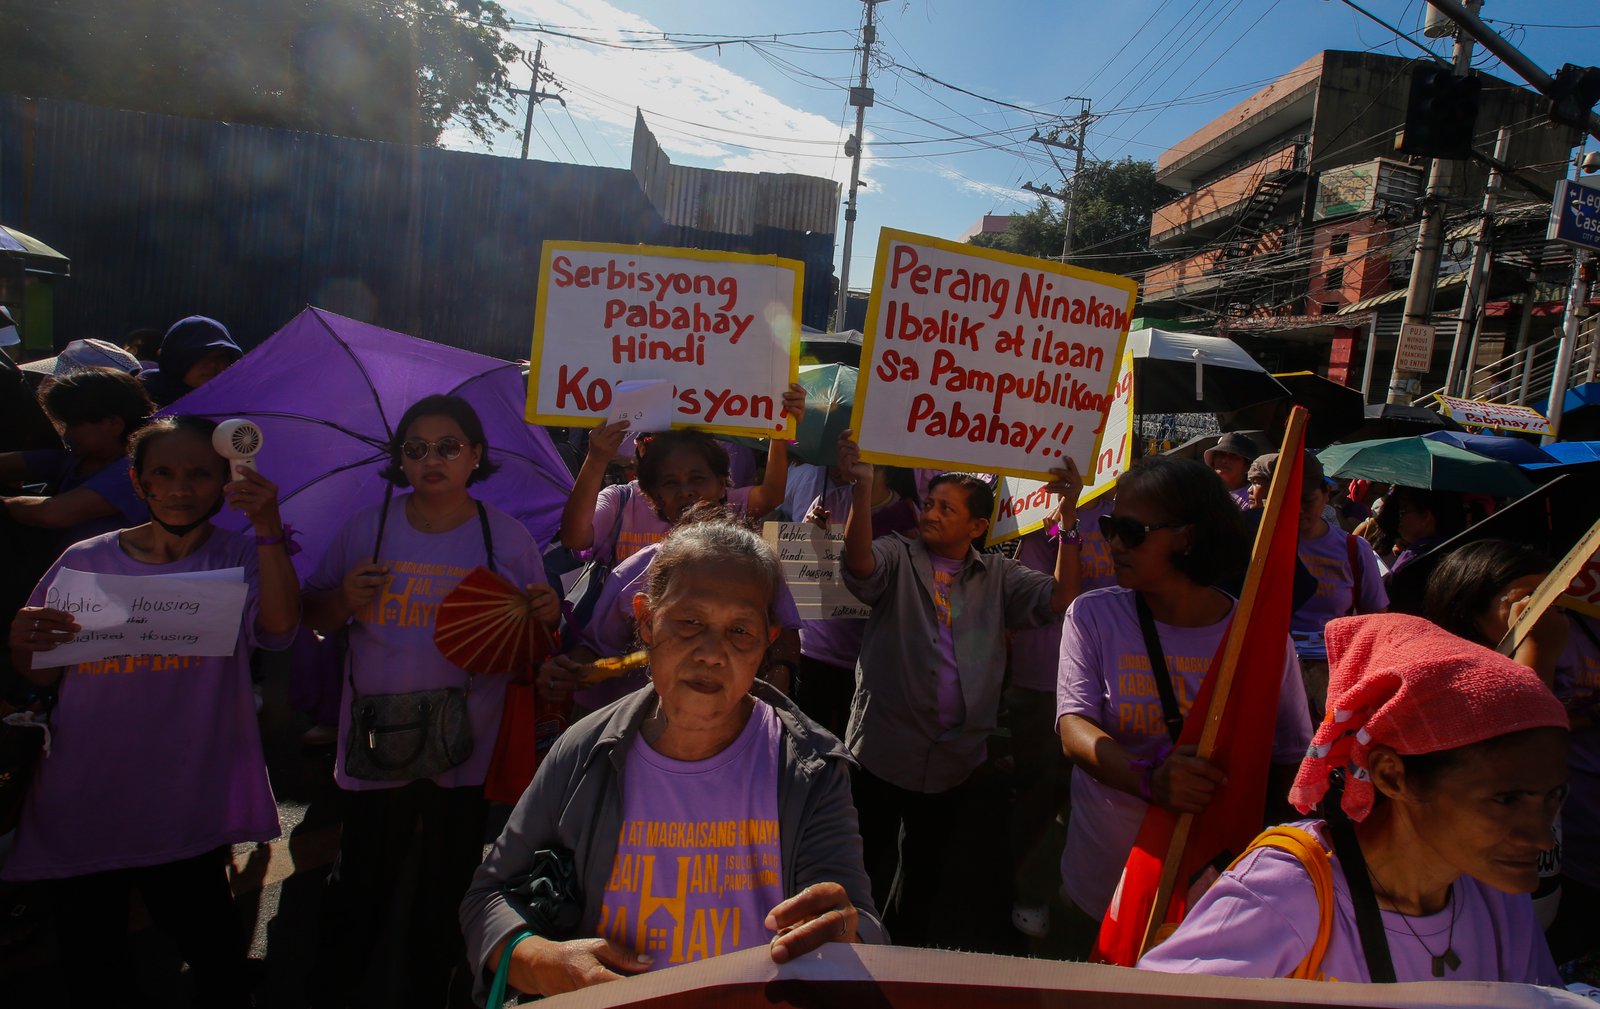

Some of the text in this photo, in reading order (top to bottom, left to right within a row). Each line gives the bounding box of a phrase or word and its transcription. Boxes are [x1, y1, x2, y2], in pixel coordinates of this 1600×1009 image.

[552, 255, 737, 311] Serbisyong
[890, 245, 1135, 332] Perang Ninakaw
[604, 298, 754, 344] Pabahay
[612, 333, 705, 365] Hindi
[995, 325, 1025, 357] at
[1399, 358, 1427, 368] NO ENTRY
[556, 364, 791, 432] Kosyon!
[907, 392, 1074, 457] Pabahay!!
[1464, 412, 1529, 430] Pabahay
[778, 523, 845, 542] Public Housi
[780, 549, 804, 561] Hindi
[798, 564, 834, 581] Housing
[47, 586, 200, 615] Public Housing
[140, 630, 199, 645] Housing
[628, 821, 643, 846] AT
[646, 820, 737, 848] MAGKAISANG
